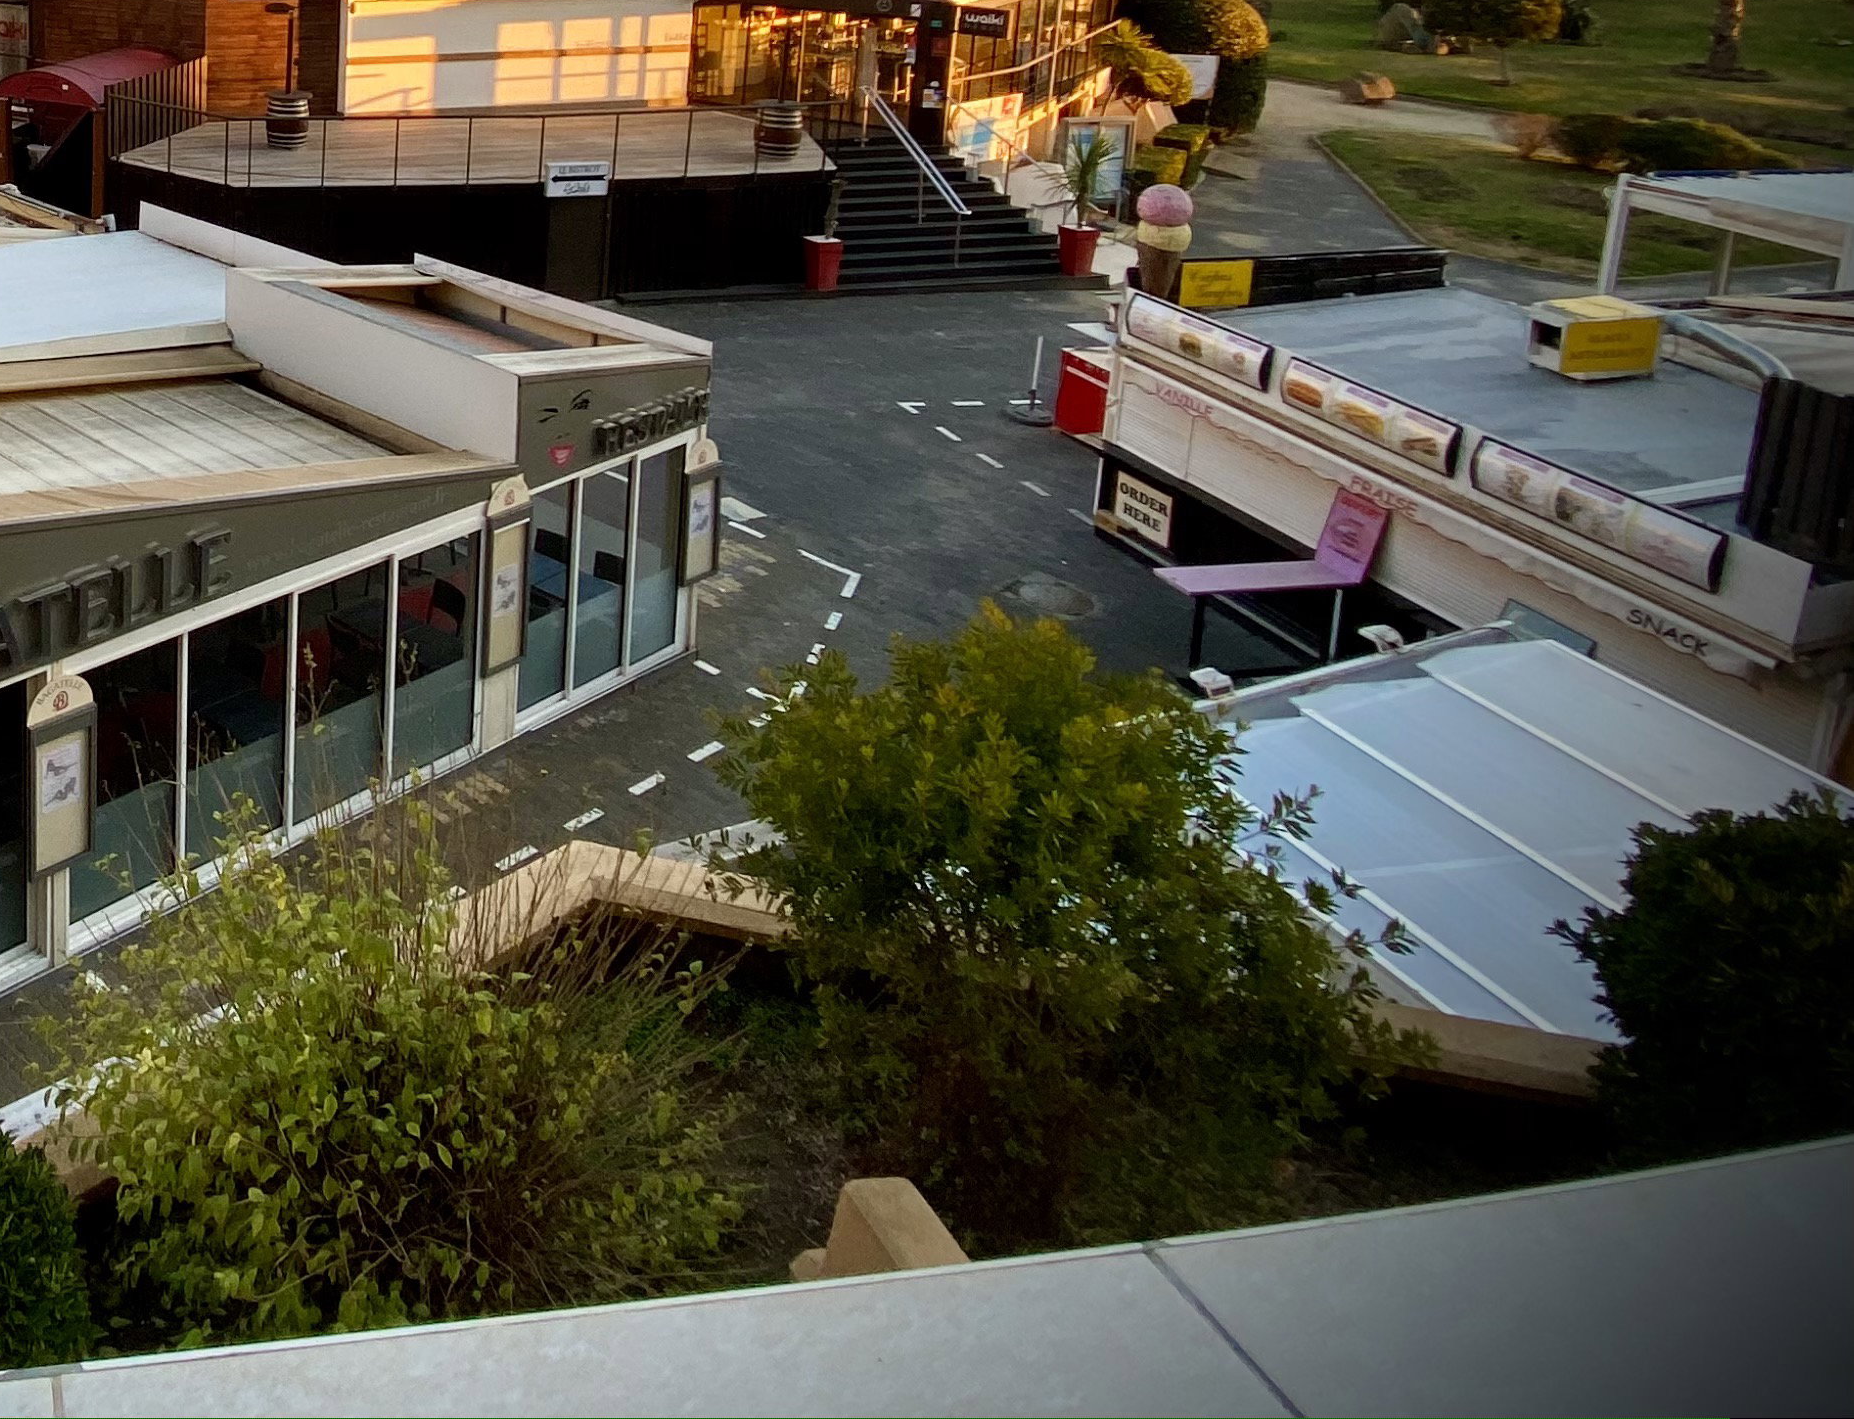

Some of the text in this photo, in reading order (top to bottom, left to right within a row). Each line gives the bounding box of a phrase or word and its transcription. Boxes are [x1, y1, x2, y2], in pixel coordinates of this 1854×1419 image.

[1120, 483, 1168, 517] ORDER
[1123, 502, 1161, 532] HERE
[1626, 609, 1709, 657] SNACK
